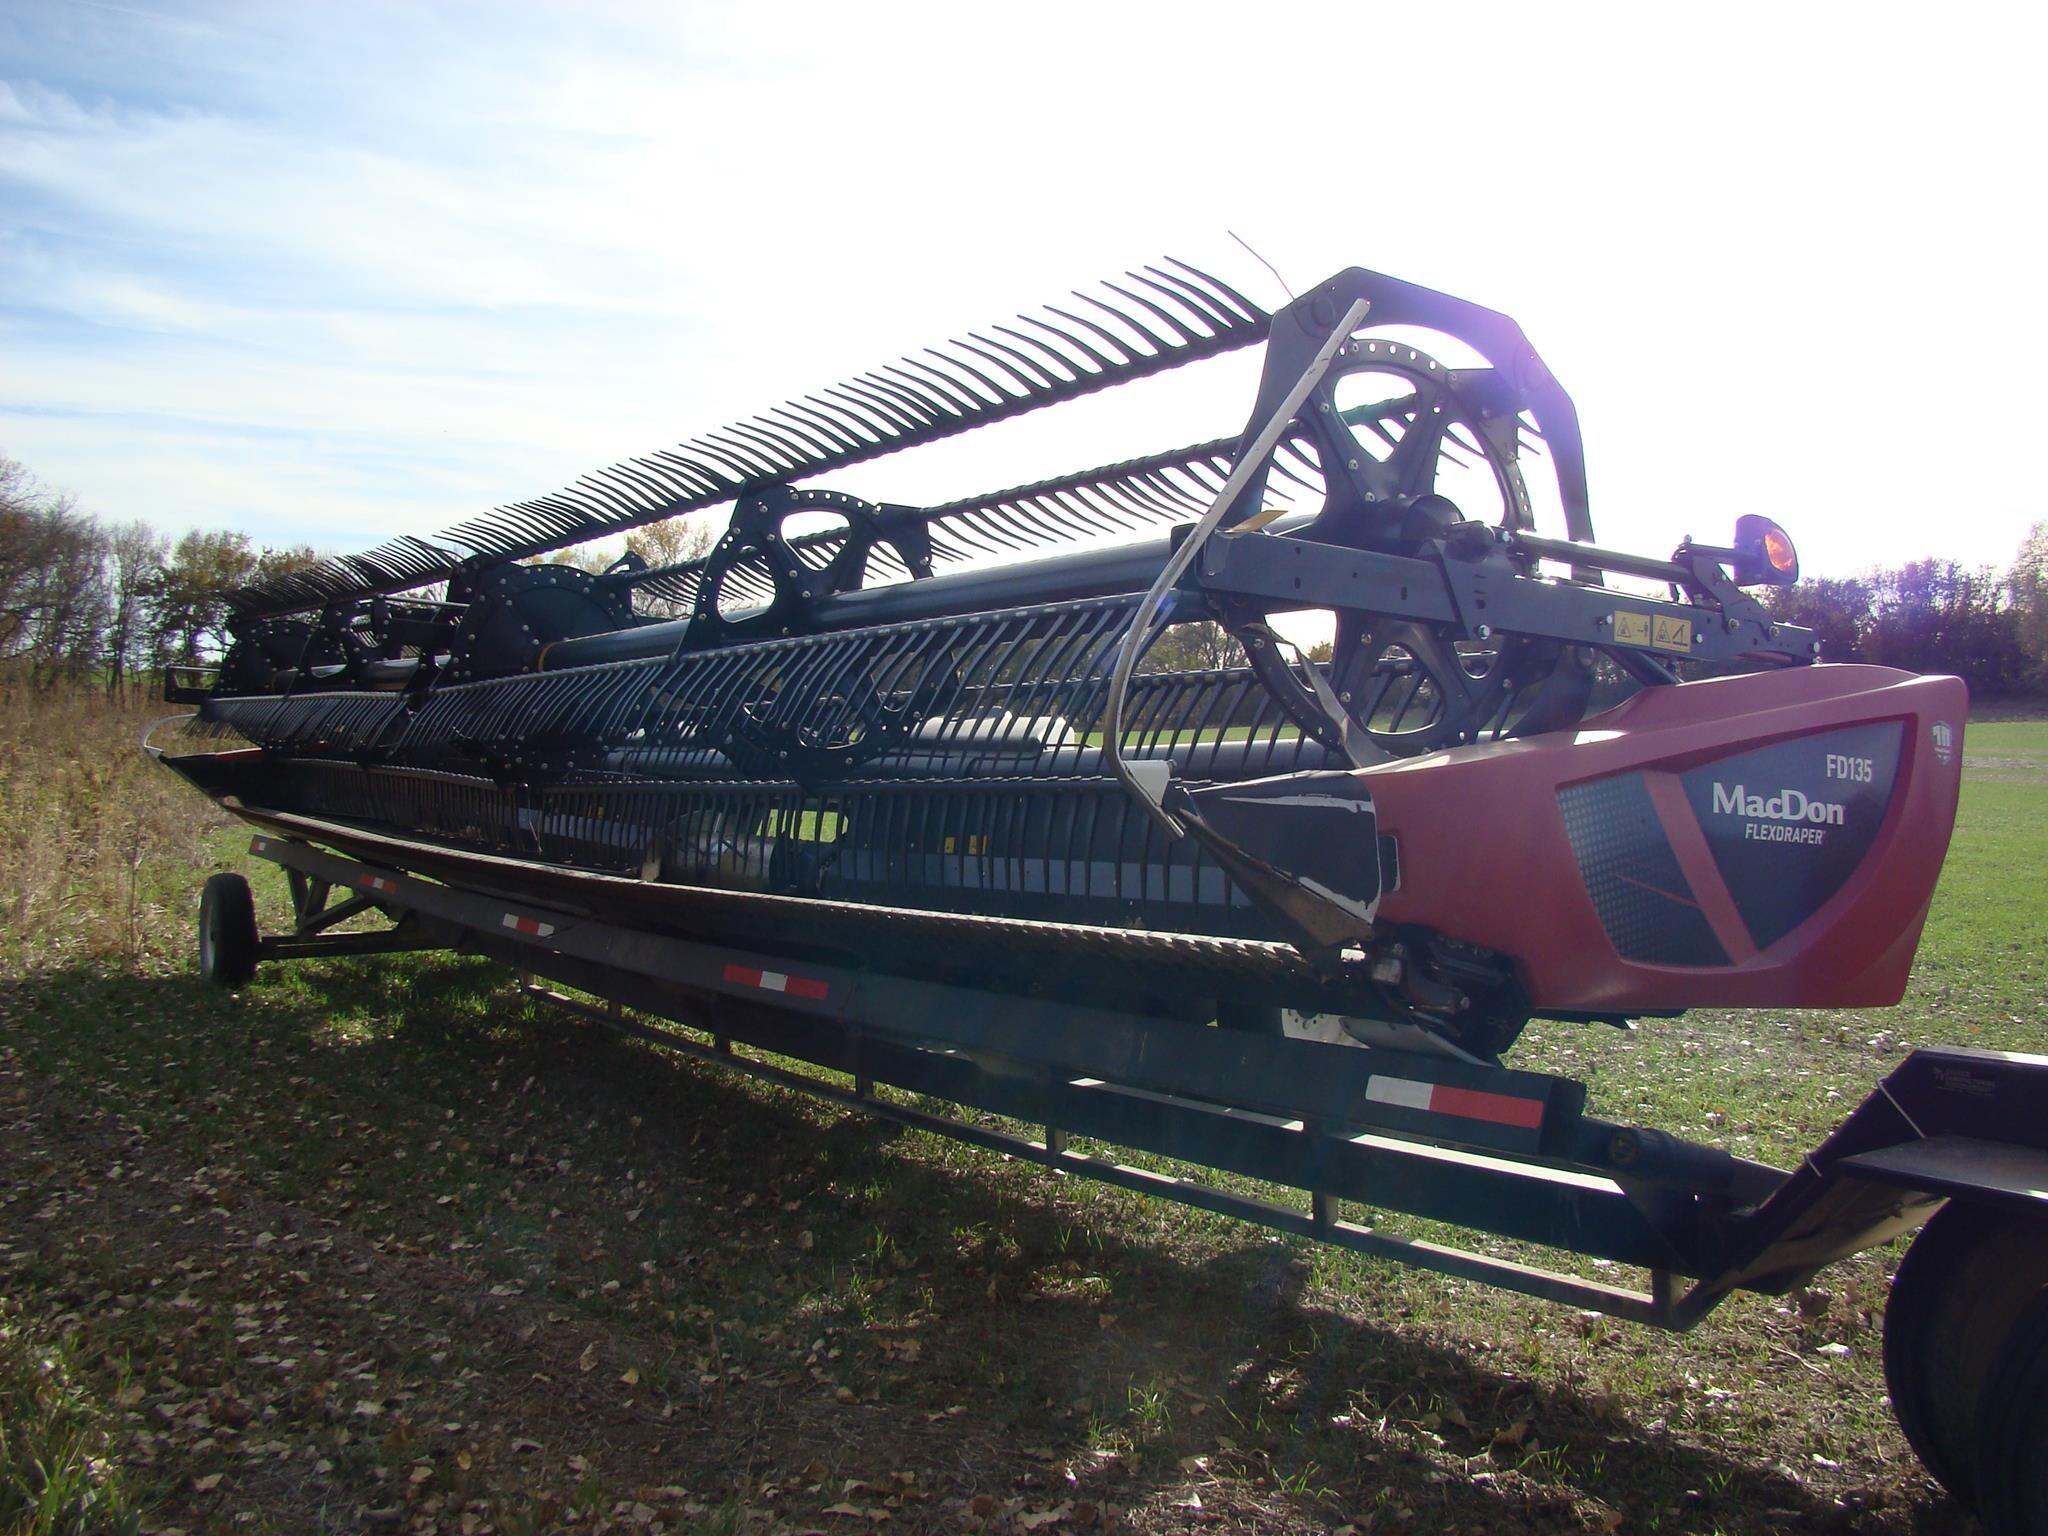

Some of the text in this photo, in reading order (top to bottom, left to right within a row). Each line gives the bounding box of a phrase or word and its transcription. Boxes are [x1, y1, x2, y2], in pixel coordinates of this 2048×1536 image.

[1826, 753, 1872, 783] FD135
[1712, 782, 1845, 825] MacDon
[1745, 823, 1823, 845] FLEXDRAPER
